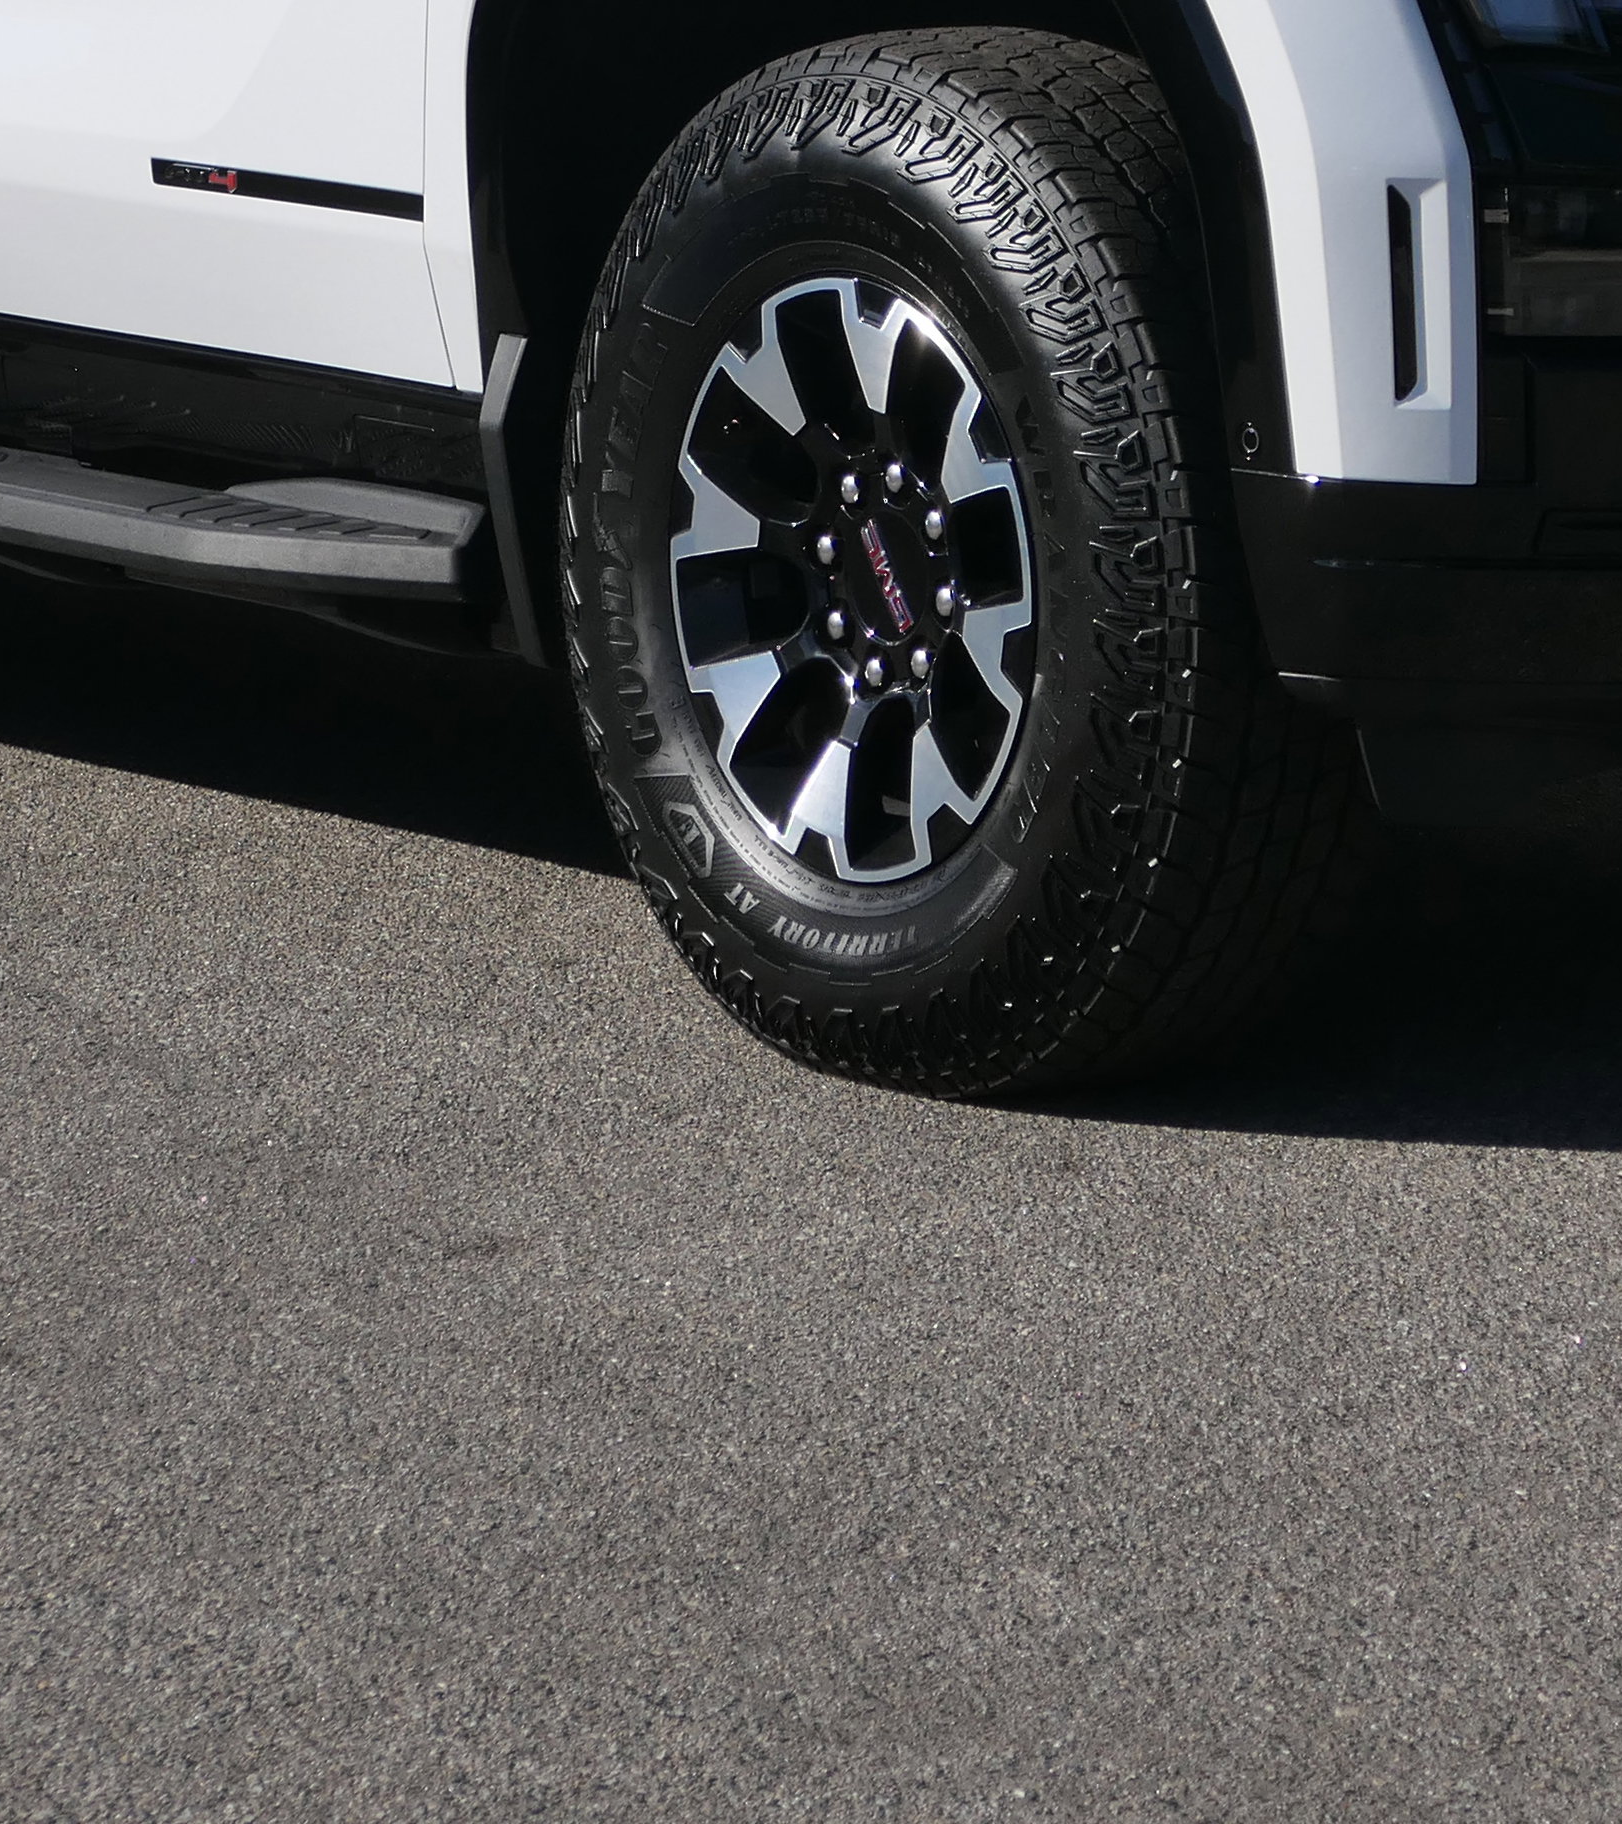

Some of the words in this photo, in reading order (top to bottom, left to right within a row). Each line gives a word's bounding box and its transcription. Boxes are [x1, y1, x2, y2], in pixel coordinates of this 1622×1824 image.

[592, 322, 669, 757] GOODYEAR
[859, 517, 915, 636] GMC
[723, 882, 760, 916] AT
[766, 914, 919, 957] TERRITORY
